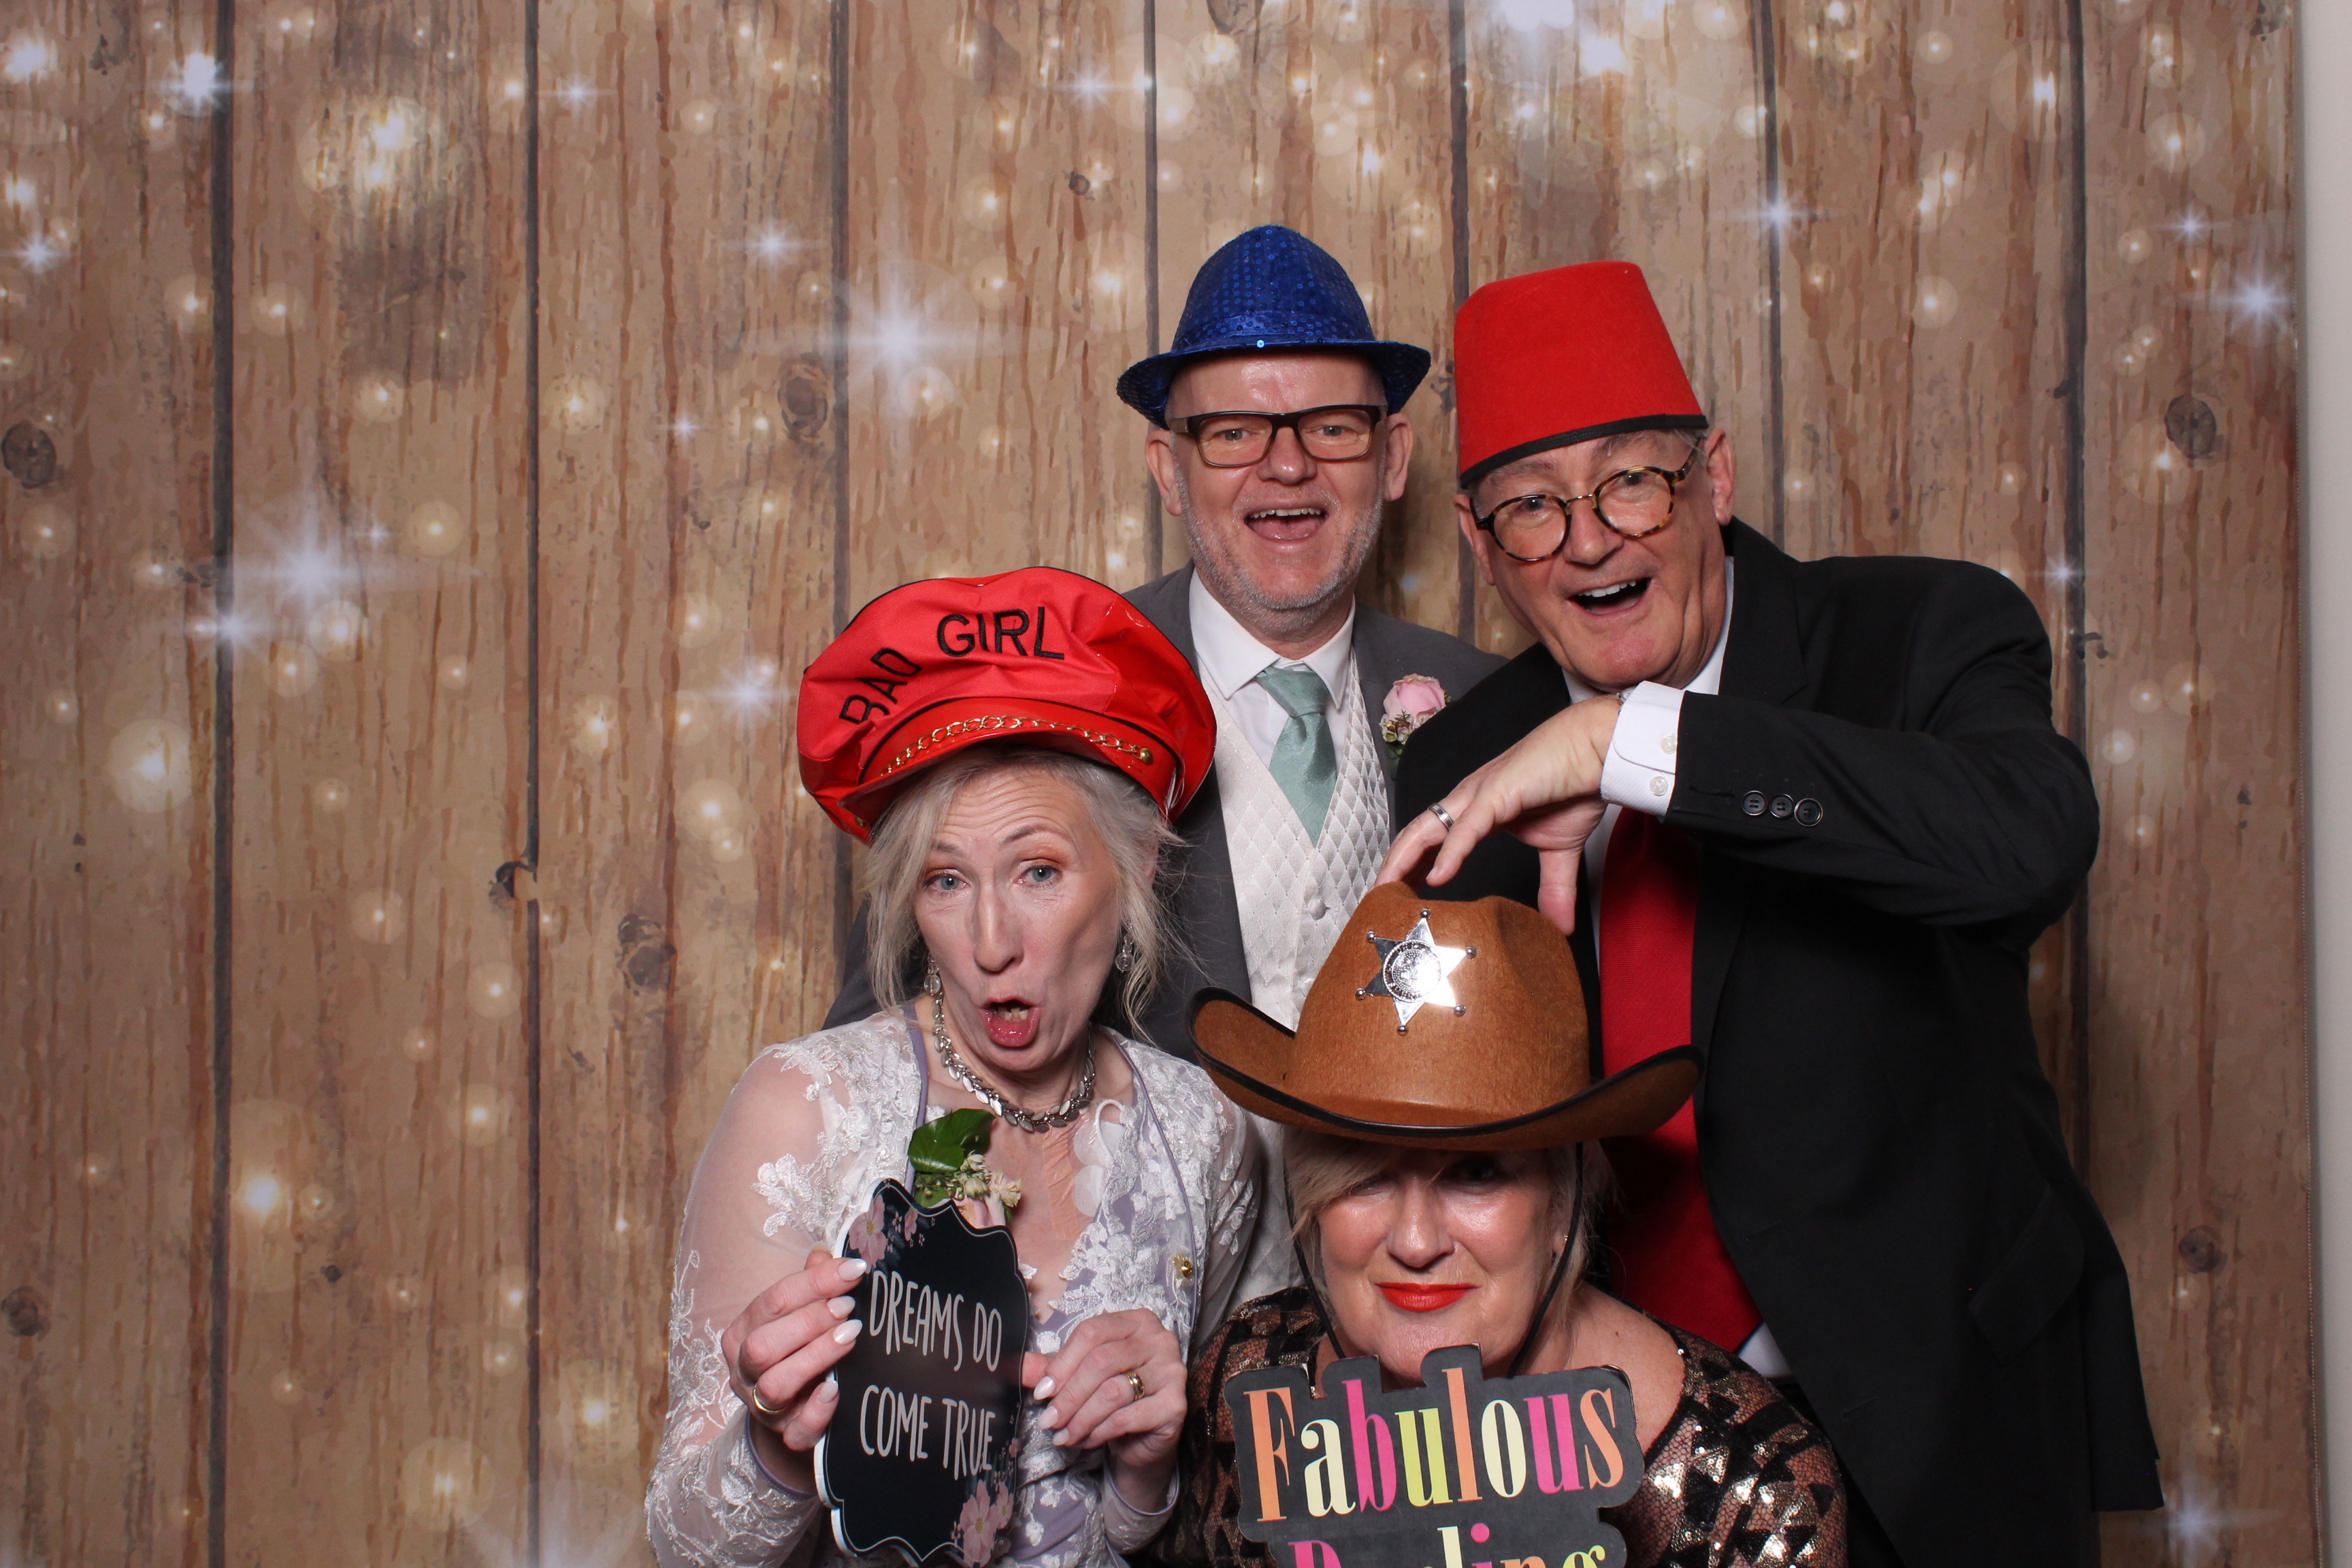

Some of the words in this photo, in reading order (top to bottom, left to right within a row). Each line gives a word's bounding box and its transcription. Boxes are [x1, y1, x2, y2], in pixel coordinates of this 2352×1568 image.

[840, 648, 921, 724] BAD
[937, 606, 1064, 659] GIRL
[870, 1271, 964, 1371] DREAMS
[974, 1303, 1002, 1371] DO
[860, 1385, 932, 1462] COME
[942, 1399, 996, 1480] TRUE
[1243, 1367, 1624, 1522] Fabulous
